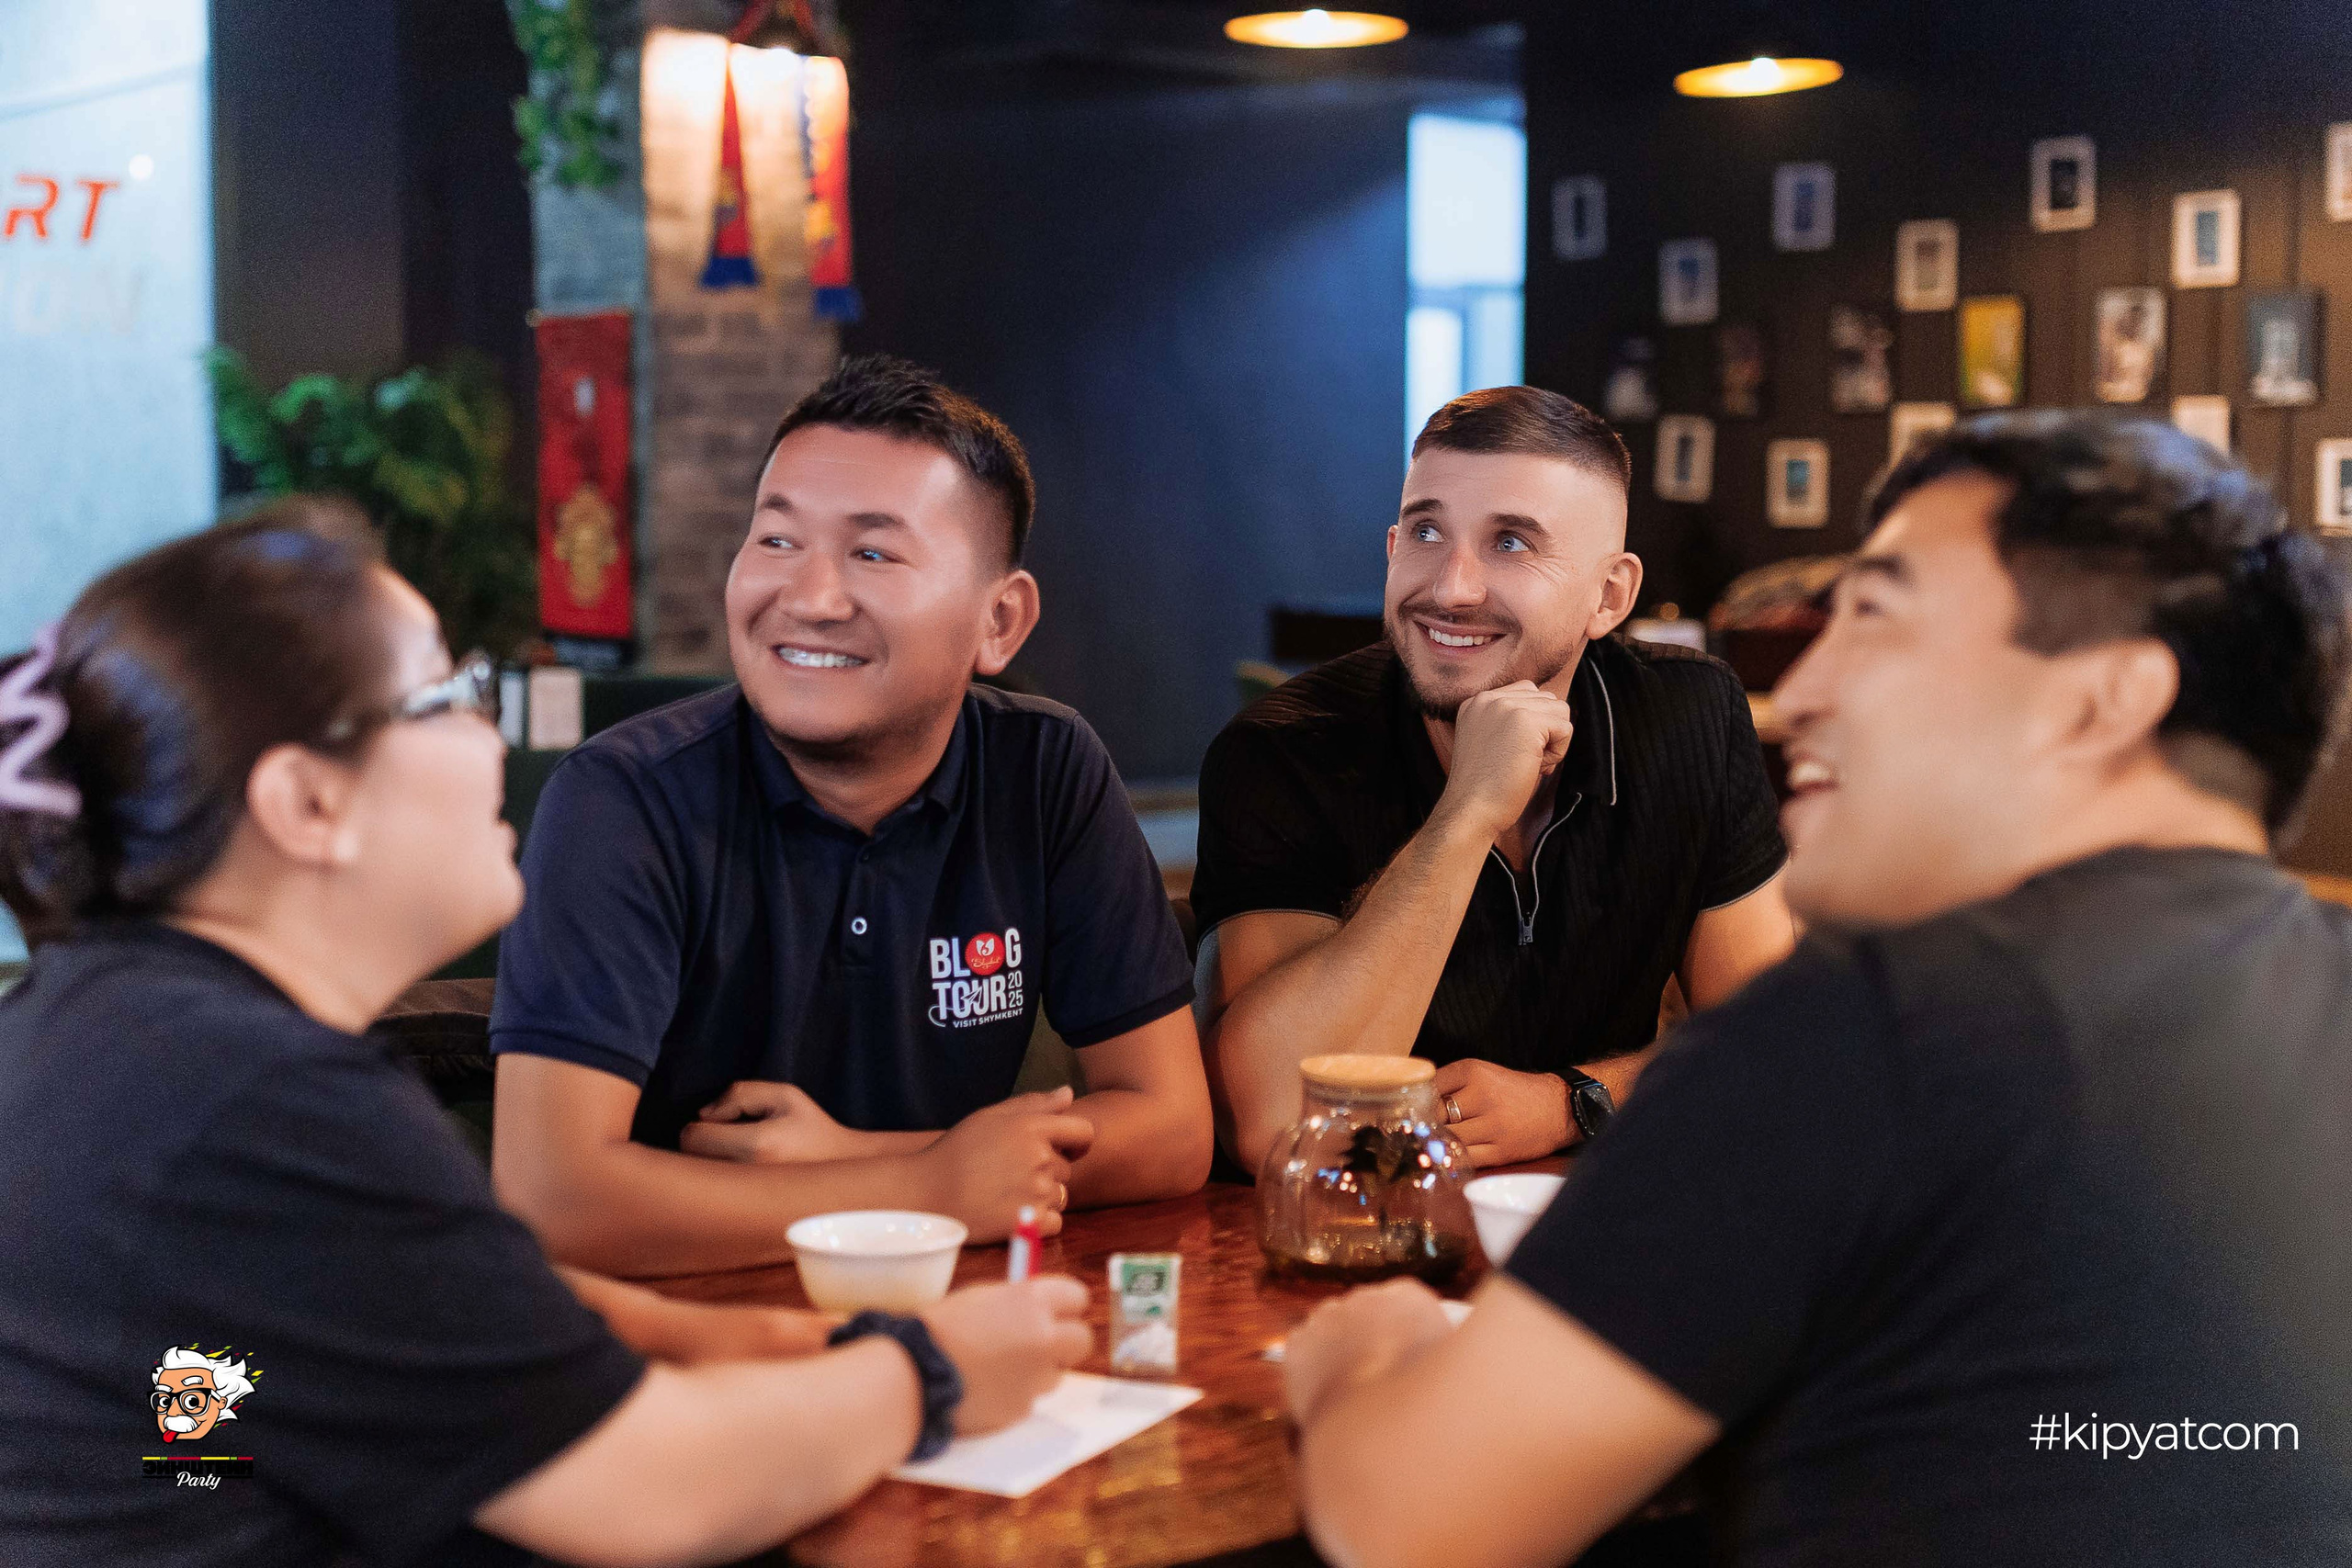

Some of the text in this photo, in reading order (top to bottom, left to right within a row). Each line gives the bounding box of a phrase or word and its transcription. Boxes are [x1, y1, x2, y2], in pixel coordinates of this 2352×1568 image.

[930, 928, 1023, 979] BLOG
[1008, 970, 1023, 989] 20
[932, 975, 1007, 1020] TOUR
[1008, 989, 1023, 1008] 25
[953, 1009, 1023, 1029] VISIT SHYMKENT
